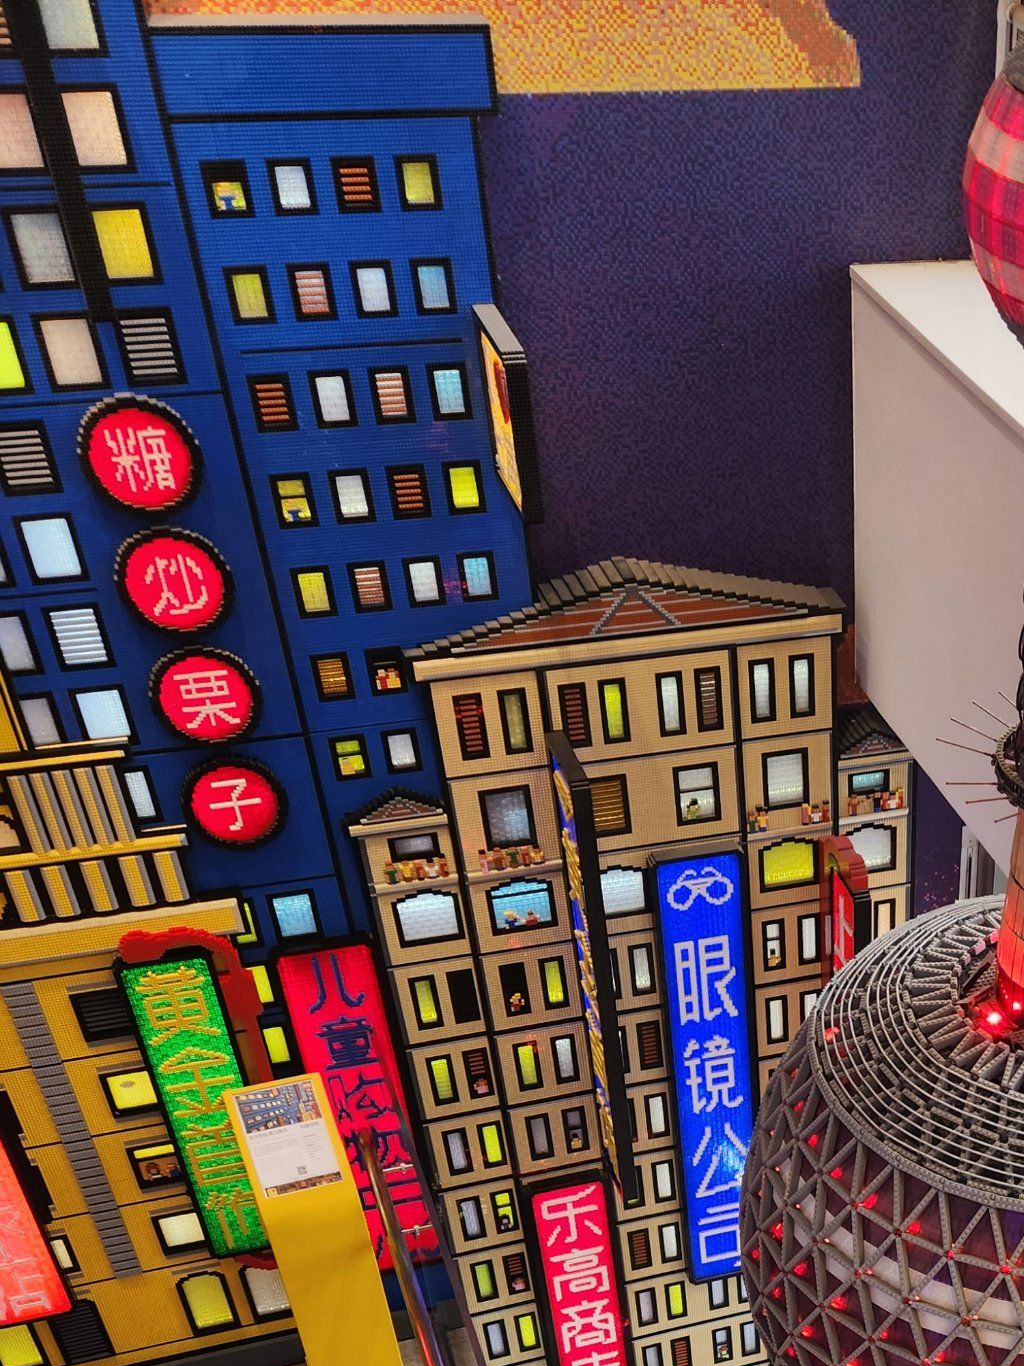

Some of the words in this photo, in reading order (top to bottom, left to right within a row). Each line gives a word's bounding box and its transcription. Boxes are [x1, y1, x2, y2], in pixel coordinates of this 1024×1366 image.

[104, 425, 262, 832] 糖炒栗子
[673, 935, 747, 1268] 眼镜公司
